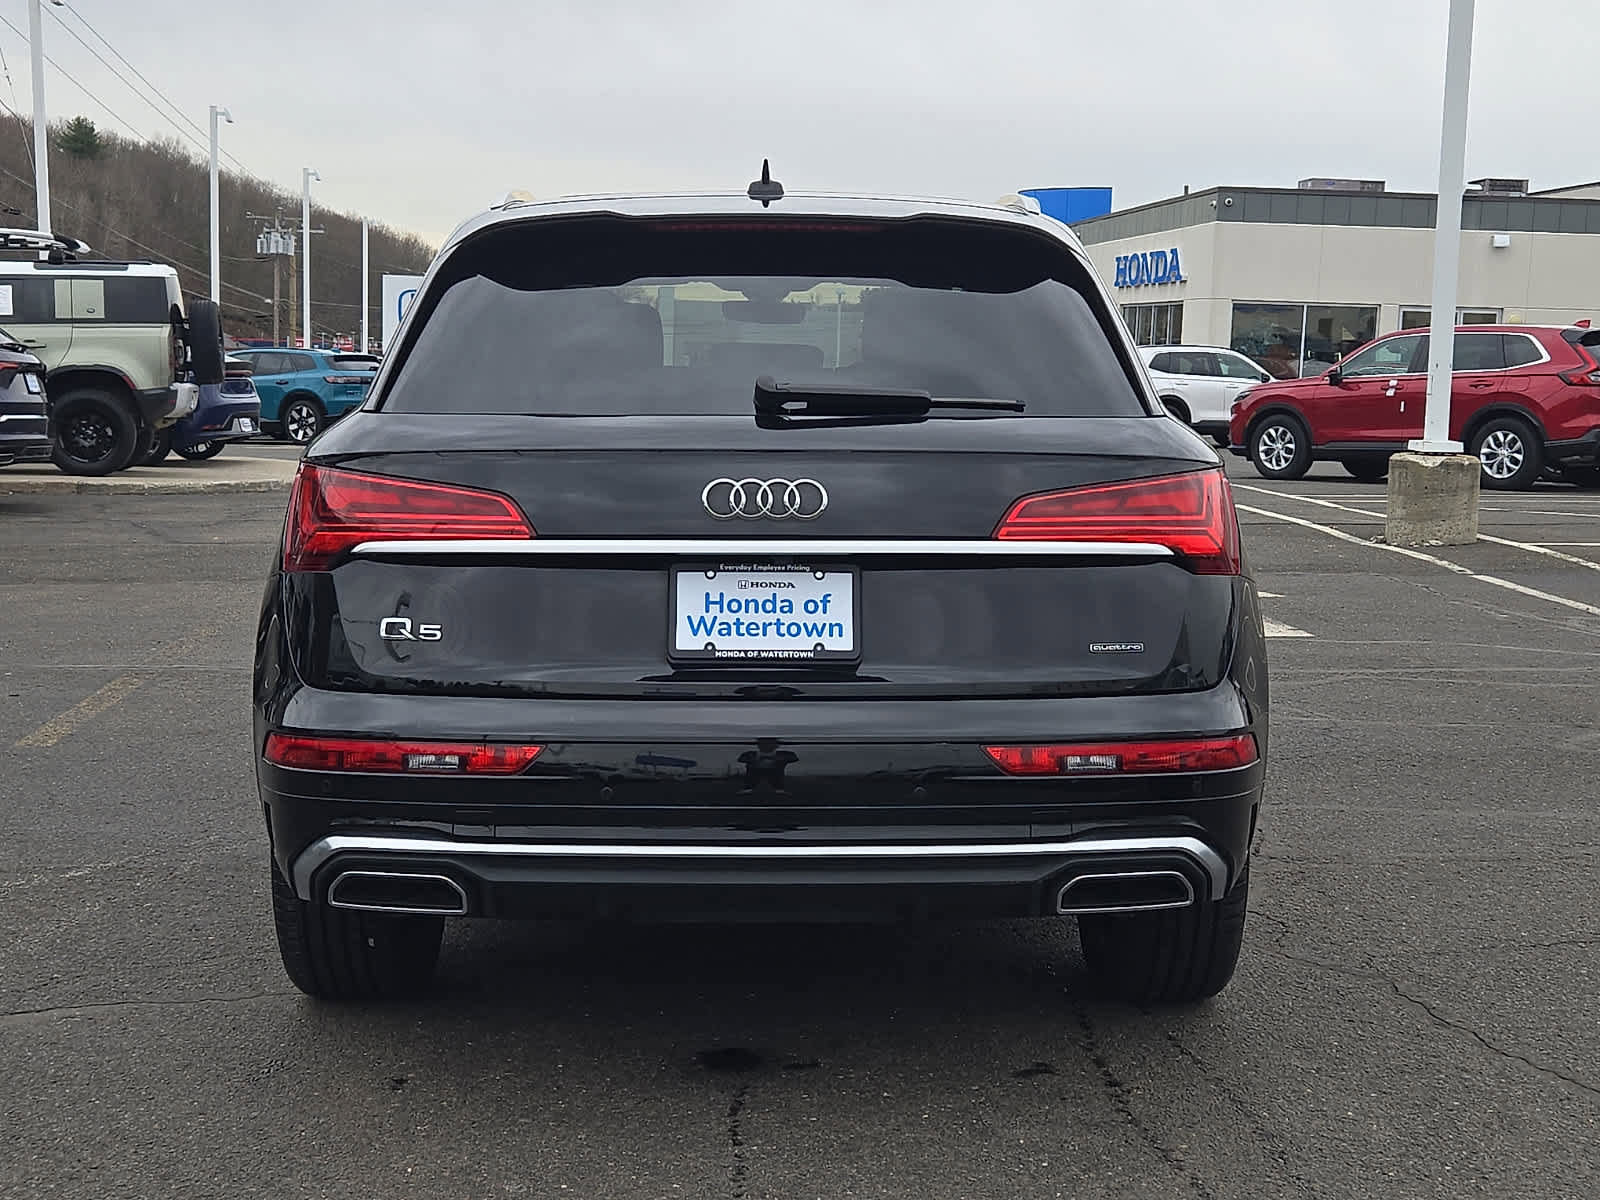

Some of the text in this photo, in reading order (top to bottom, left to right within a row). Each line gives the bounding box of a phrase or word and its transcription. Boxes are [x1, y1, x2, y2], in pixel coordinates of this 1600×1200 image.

[1114, 248, 1183, 288] HONDA
[719, 563, 810, 572] Everyday Employee Pricing
[750, 581, 796, 589] HONDA
[704, 592, 833, 614] Honda of
[380, 617, 442, 640] Q5
[687, 615, 844, 638] Watertown
[715, 650, 814, 658] HONDA OF WATERTOWN
[1091, 643, 1142, 652] quattro
